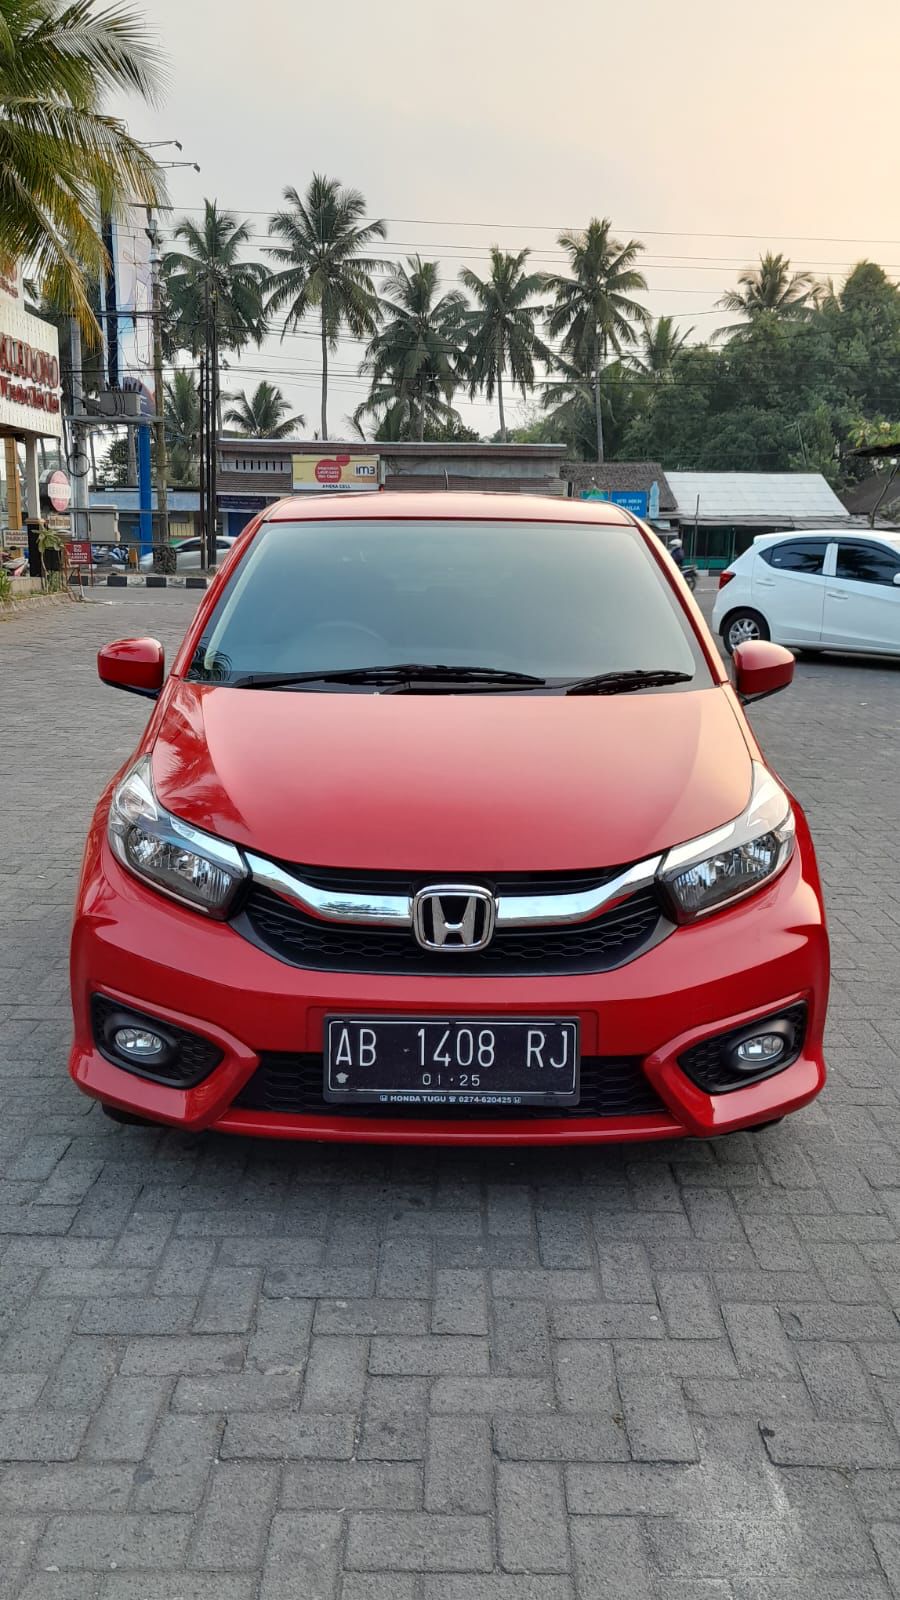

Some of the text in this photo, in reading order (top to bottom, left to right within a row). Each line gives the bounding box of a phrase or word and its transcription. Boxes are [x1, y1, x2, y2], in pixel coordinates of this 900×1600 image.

[336, 1029, 568, 1068] AB 1408 RJ
